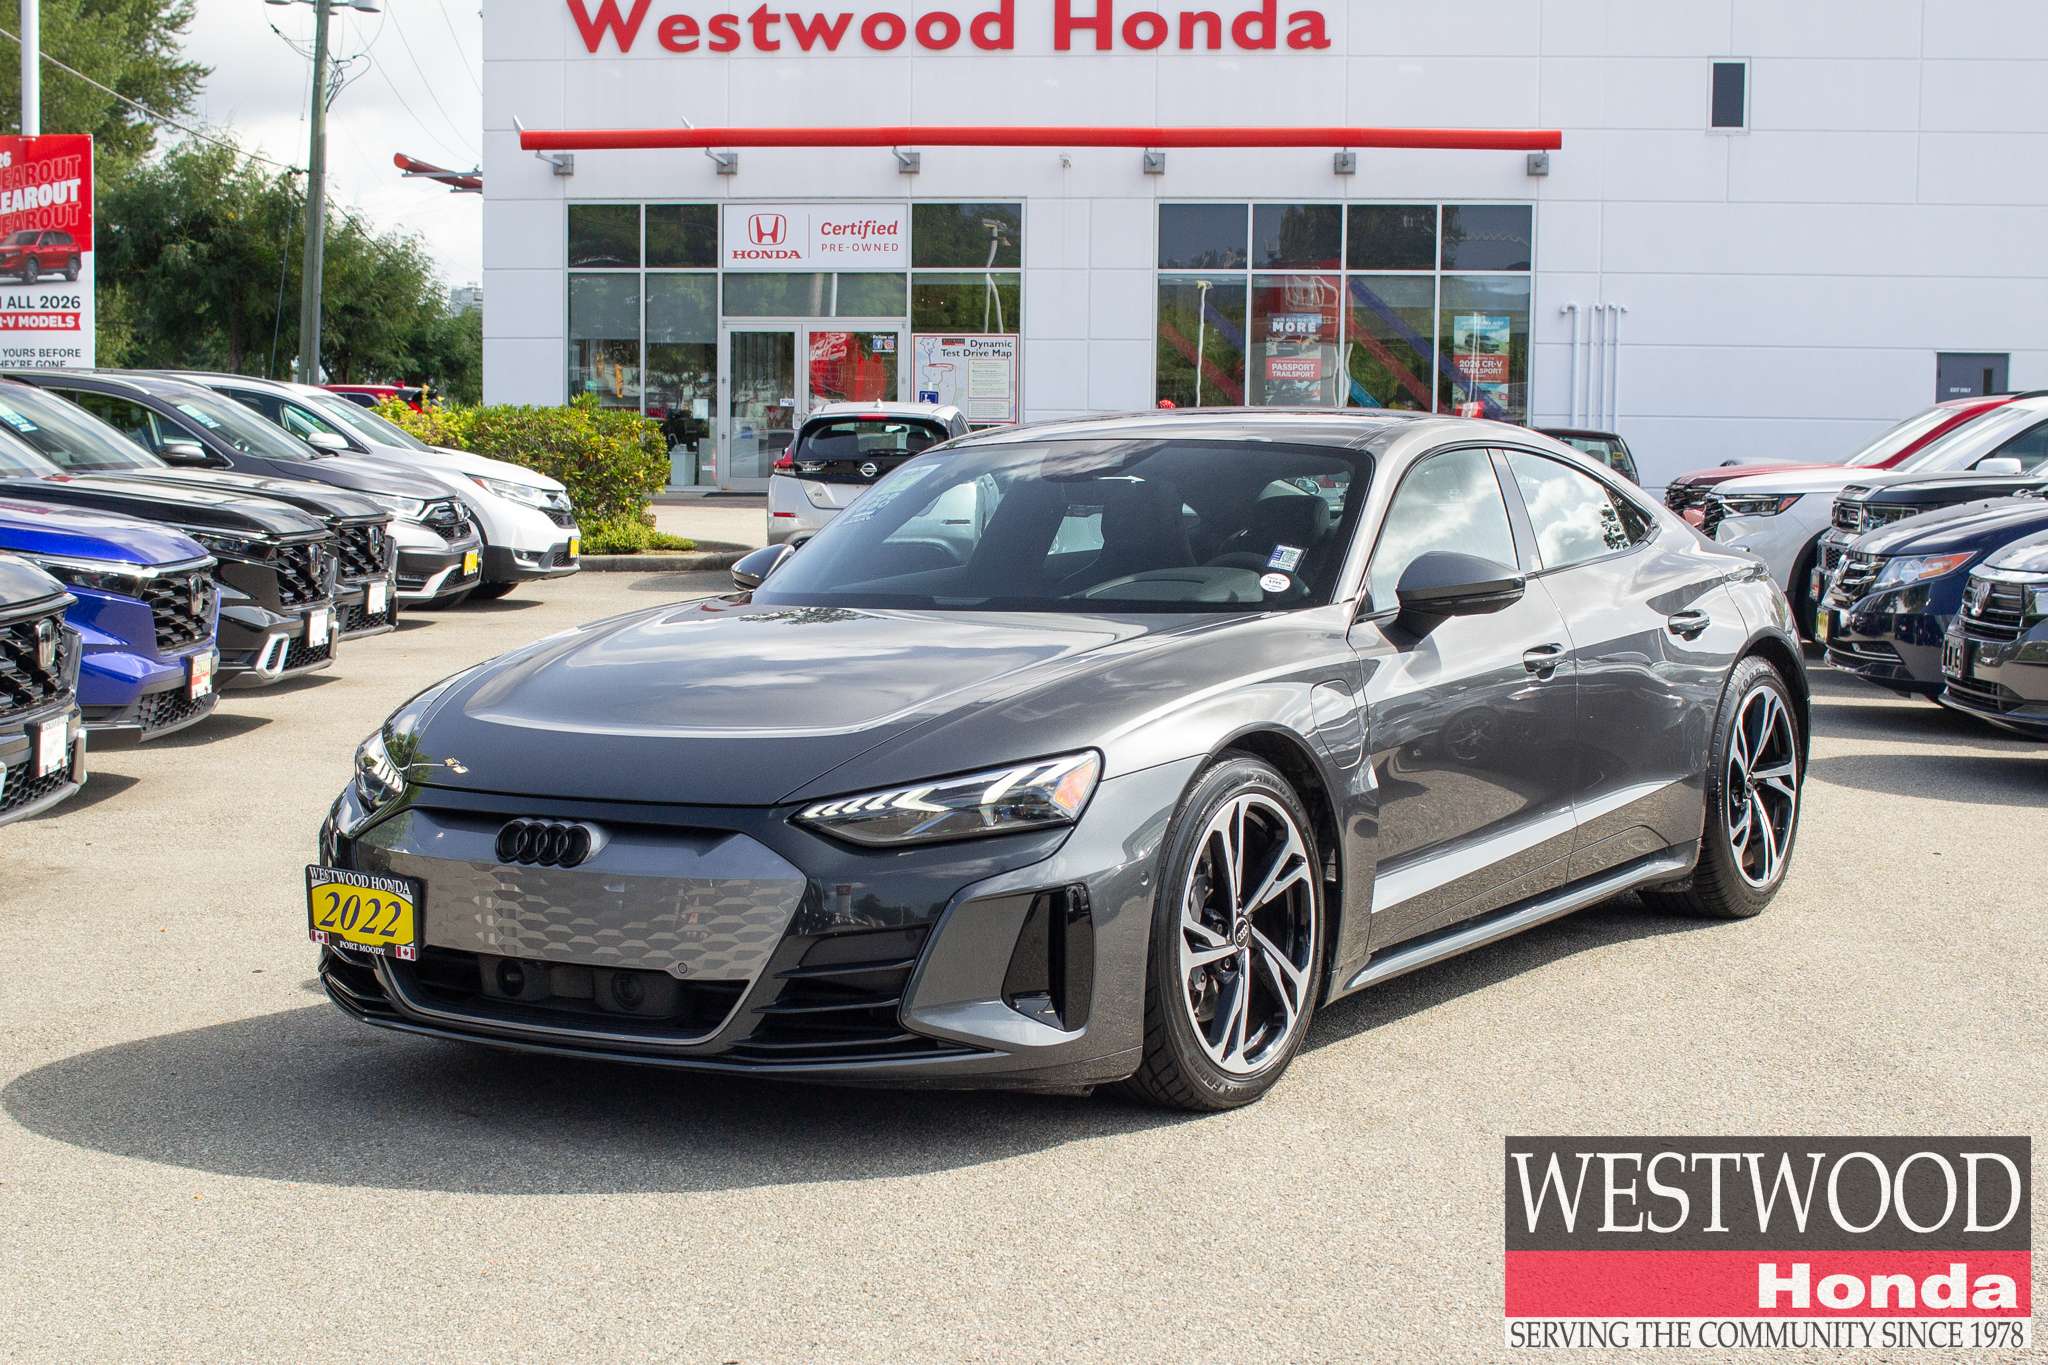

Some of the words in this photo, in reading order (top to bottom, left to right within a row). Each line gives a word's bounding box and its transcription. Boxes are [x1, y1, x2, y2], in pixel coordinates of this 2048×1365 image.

[566, 0, 1014, 53] Westwood
[1054, 0, 1331, 51] Honda
[0, 154, 81, 190] EAROUT
[0, 178, 81, 215] EAROUT
[0, 201, 81, 237] EAROUT
[821, 220, 898, 239] Certified
[821, 243, 899, 252] PRE-OWNED
[732, 250, 802, 259] HONDA
[7, 296, 35, 309] ALL
[40, 296, 81, 309] 2026
[18, 315, 75, 328] MODELS
[1272, 321, 1317, 333] MORE
[970, 340, 1012, 349] Dynamic
[3, 348, 36, 357] YOURS
[39, 348, 81, 357] BEFORE
[941, 349, 960, 357] Test
[963, 349, 989, 357] Drive
[992, 349, 1012, 359] Map
[1272, 363, 1315, 371] PASSPORT
[309, 866, 369, 888] WESTWOOD
[371, 877, 411, 895] HONDA
[319, 892, 402, 937] 2022
[339, 940, 359, 951] PORT
[359, 944, 386, 956] MOODY
